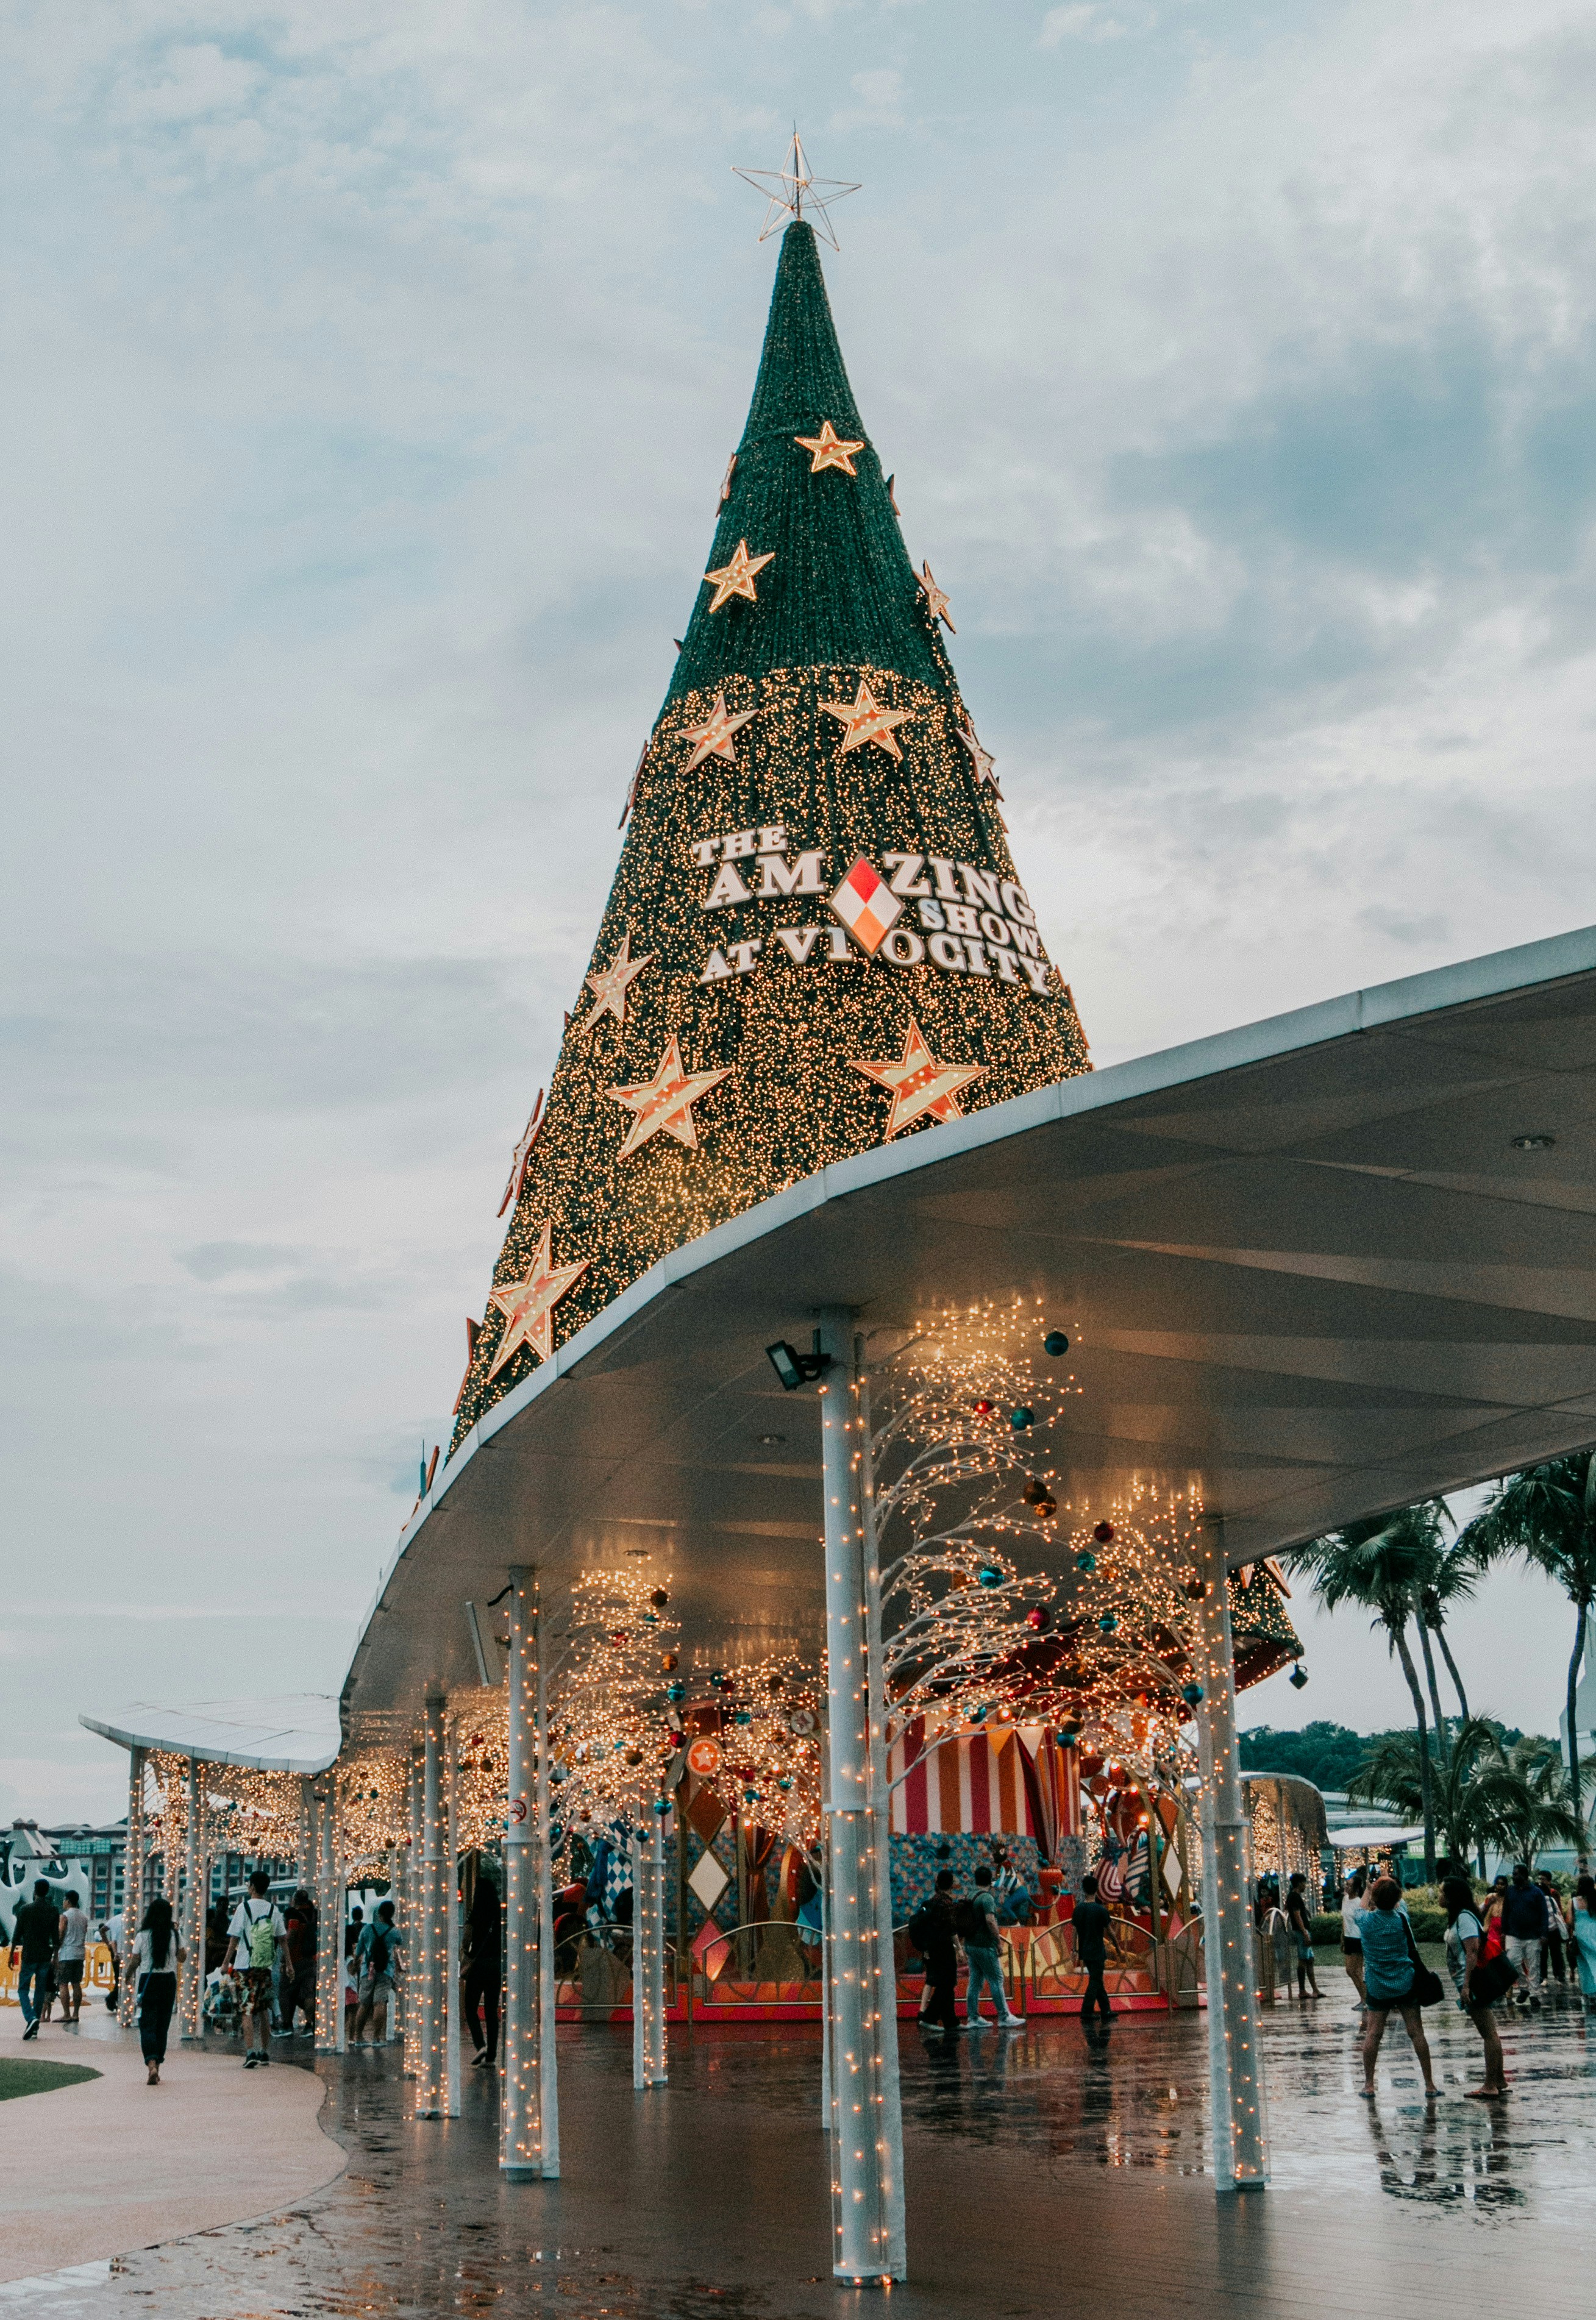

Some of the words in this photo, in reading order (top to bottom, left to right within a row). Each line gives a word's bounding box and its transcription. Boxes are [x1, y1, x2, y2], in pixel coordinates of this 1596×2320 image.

[692, 825, 787, 867] THE
[703, 850, 1036, 928] AMZING
[699, 938, 762, 983] AT
[775, 925, 1050, 996] VIOCITY
[917, 897, 1039, 958] SHOW
